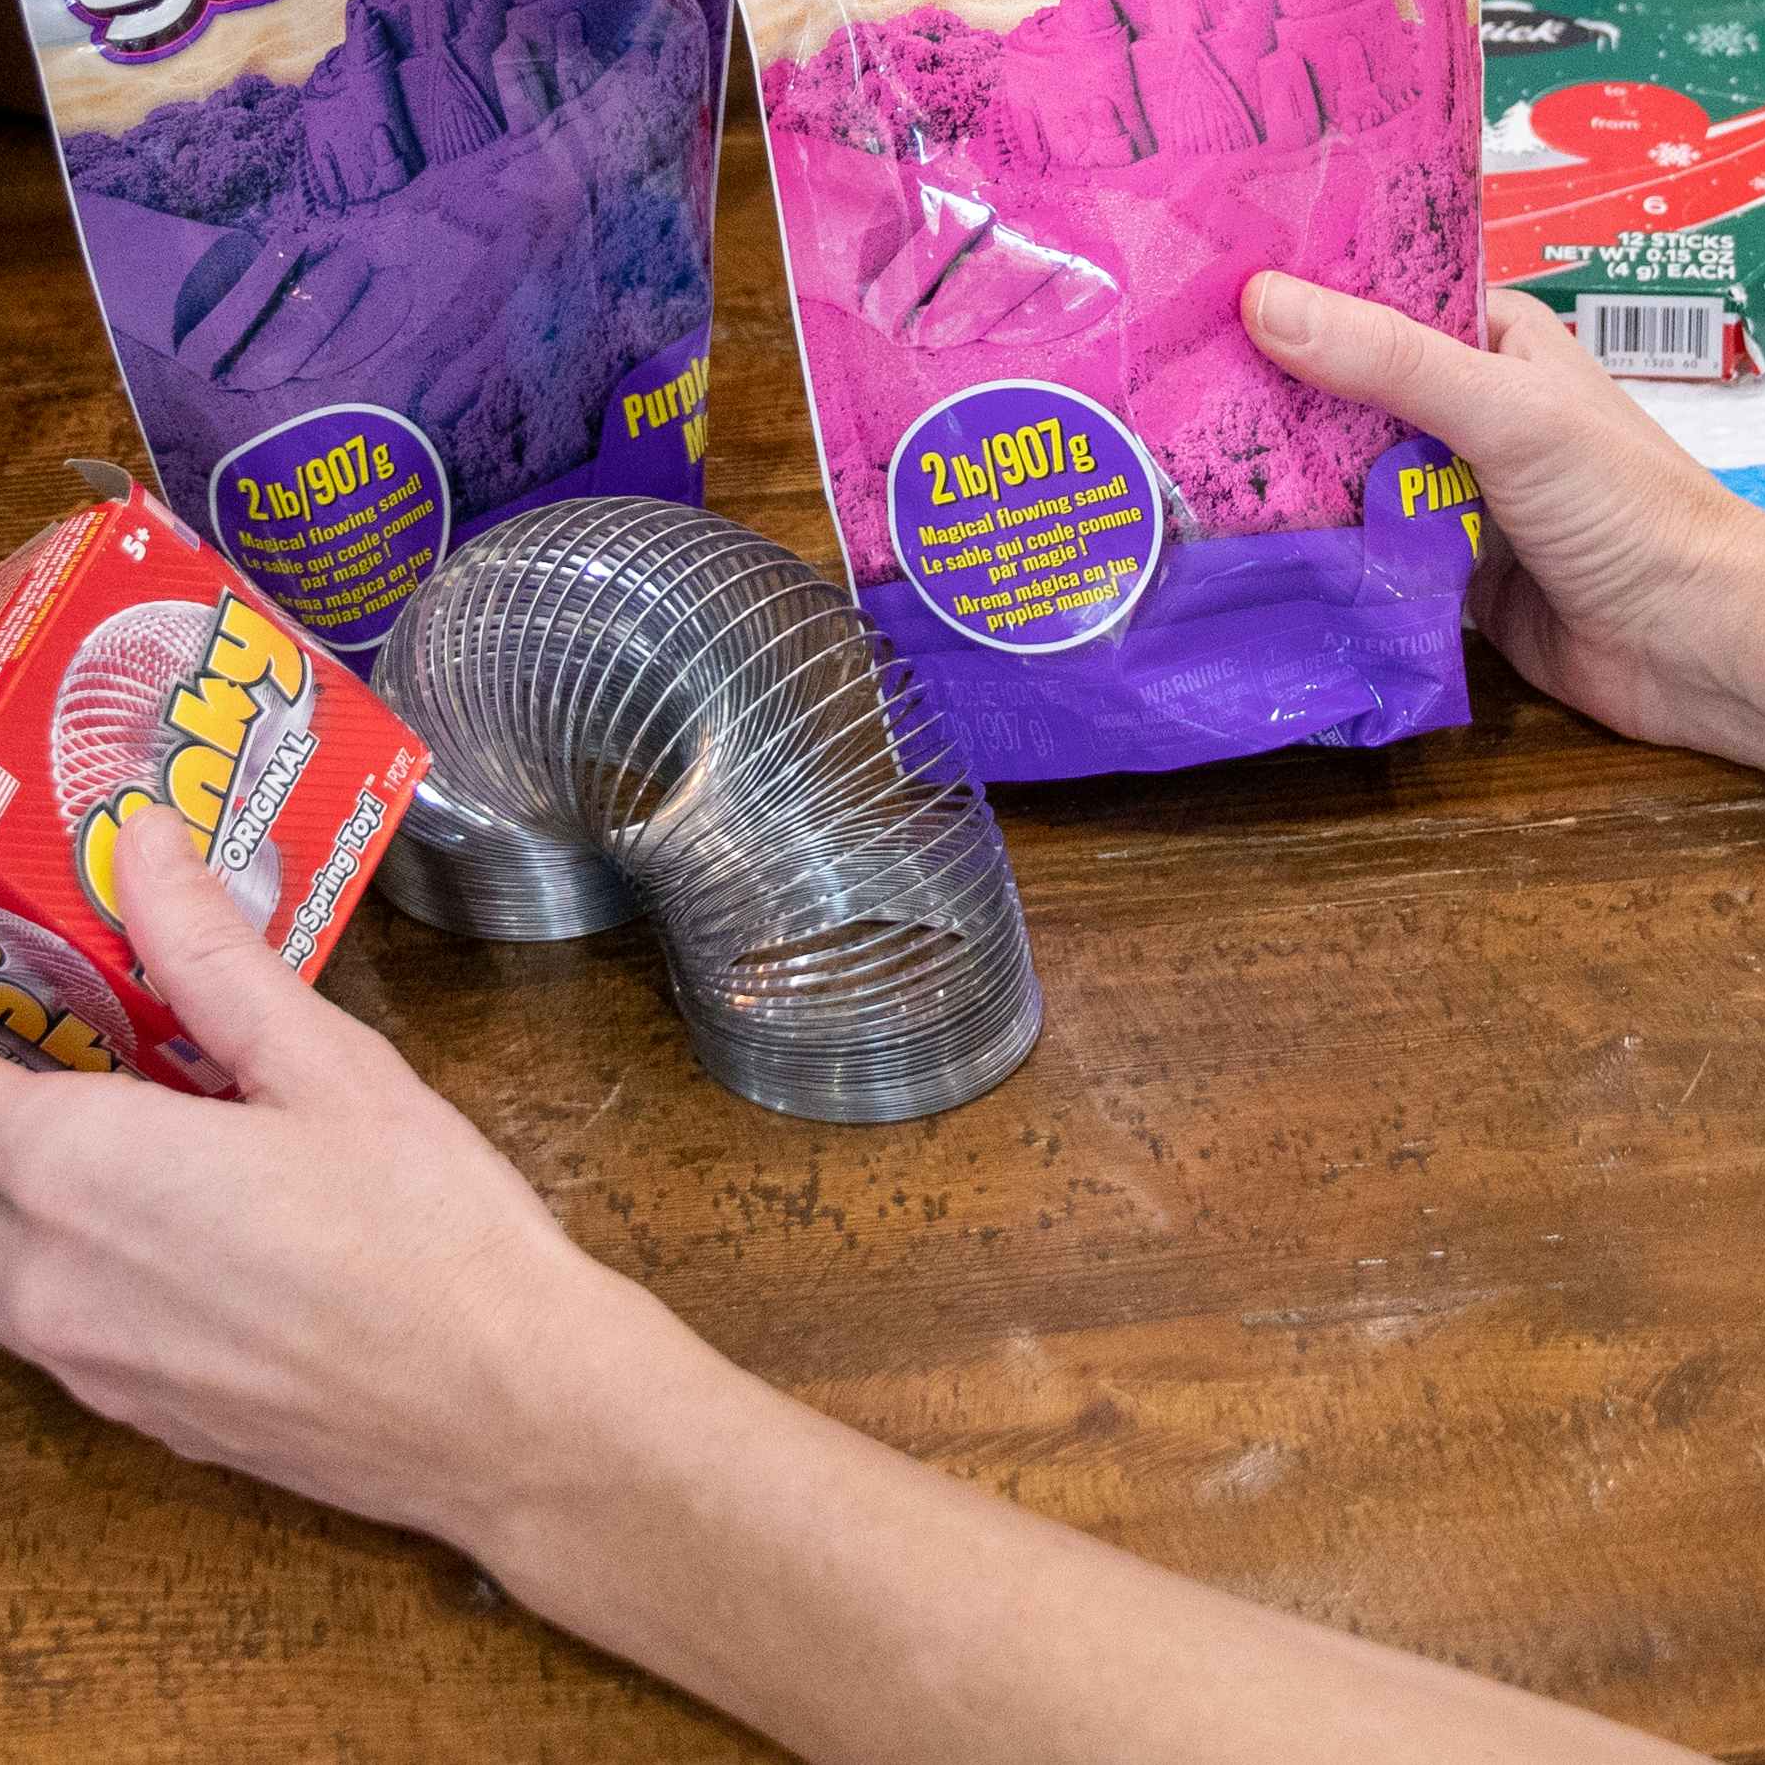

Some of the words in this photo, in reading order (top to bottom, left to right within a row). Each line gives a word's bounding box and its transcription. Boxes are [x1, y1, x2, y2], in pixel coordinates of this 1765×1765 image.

[1642, 195, 1668, 215] 6
[1544, 246, 1593, 260] NET
[1599, 247, 1640, 261] WT
[1646, 249, 1691, 263] 0.15
[1698, 250, 1734, 263] OZ
[1618, 232, 1644, 246] 12
[1652, 234, 1734, 249] STICKS
[1607, 263, 1629, 278] (4
[1637, 264, 1659, 281] g)
[1667, 264, 1734, 279] EACH
[239, 530, 306, 553] Magical
[309, 506, 378, 545] flowing
[379, 473, 423, 512] sand!
[243, 554, 261, 569] Le
[265, 558, 304, 574] sable
[308, 549, 335, 573] qui
[338, 532, 379, 561] coule
[384, 499, 434, 539] comme
[919, 513, 995, 546] Magical
[996, 495, 1072, 529] flowing
[1075, 475, 1129, 507] sand!
[118, 525, 151, 561] 5+
[921, 555, 943, 576] Le
[945, 546, 992, 572] sable
[996, 536, 1024, 562] qui
[1027, 523, 1075, 551] coule
[1078, 507, 1143, 536] comme
[988, 561, 1018, 584] par
[1022, 544, 1077, 572] magie
[301, 573, 328, 591] par
[333, 553, 383, 583] magie
[302, 605, 362, 628] propias
[365, 570, 419, 614] manos!
[327, 577, 386, 610] mágica
[389, 565, 407, 582] en
[409, 548, 432, 570] tus
[954, 592, 1012, 616] ¡Arena
[1015, 572, 1080, 602] mágica
[1083, 565, 1106, 583] en
[1107, 556, 1138, 578] tus
[987, 600, 1054, 633] propias
[1057, 578, 1120, 612] manos!
[224, 737, 312, 869] ORIGINAL
[297, 846, 357, 932] Spring
[339, 790, 384, 849] Toy!
